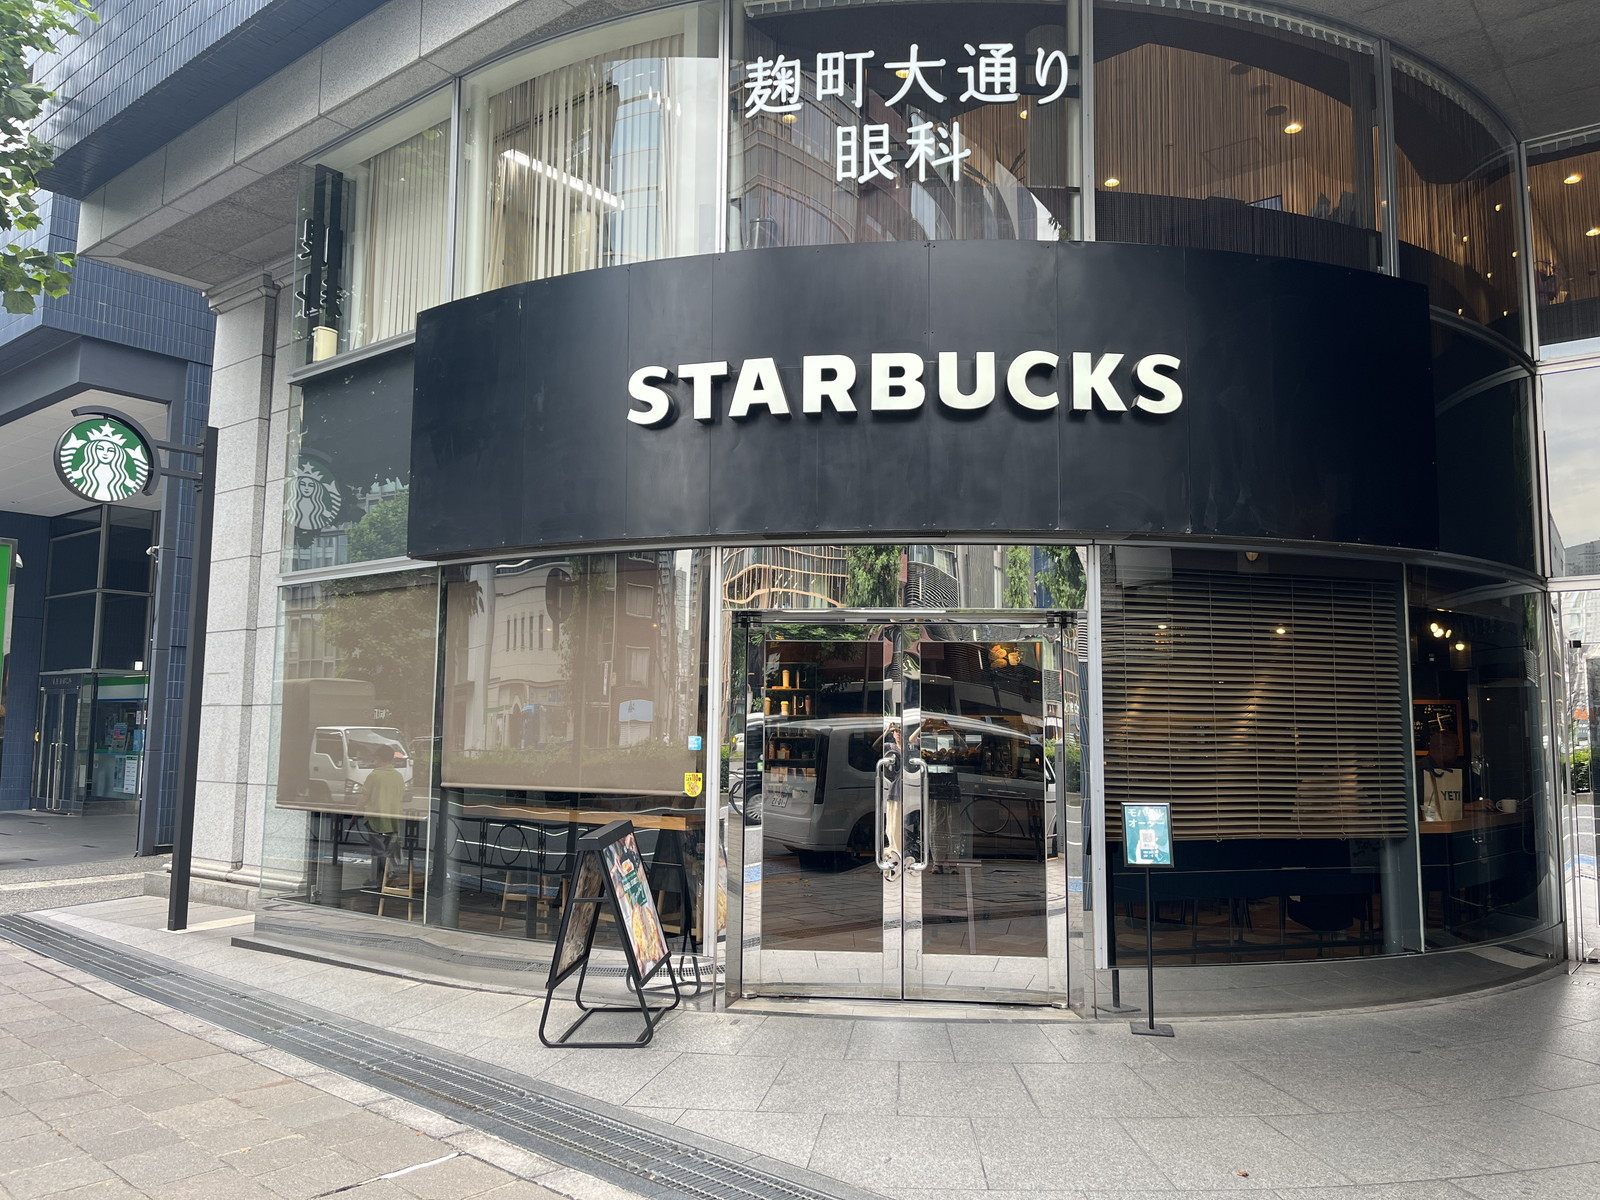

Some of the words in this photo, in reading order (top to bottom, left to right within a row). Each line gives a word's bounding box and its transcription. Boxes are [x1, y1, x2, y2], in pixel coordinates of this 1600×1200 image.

[743, 42, 1070, 119] 麹町大通り
[835, 120, 972, 184] 眼科
[626, 349, 1184, 429] STARBUCKS
[1127, 808, 1165, 818] モバル
[1440, 790, 1461, 801] YETI
